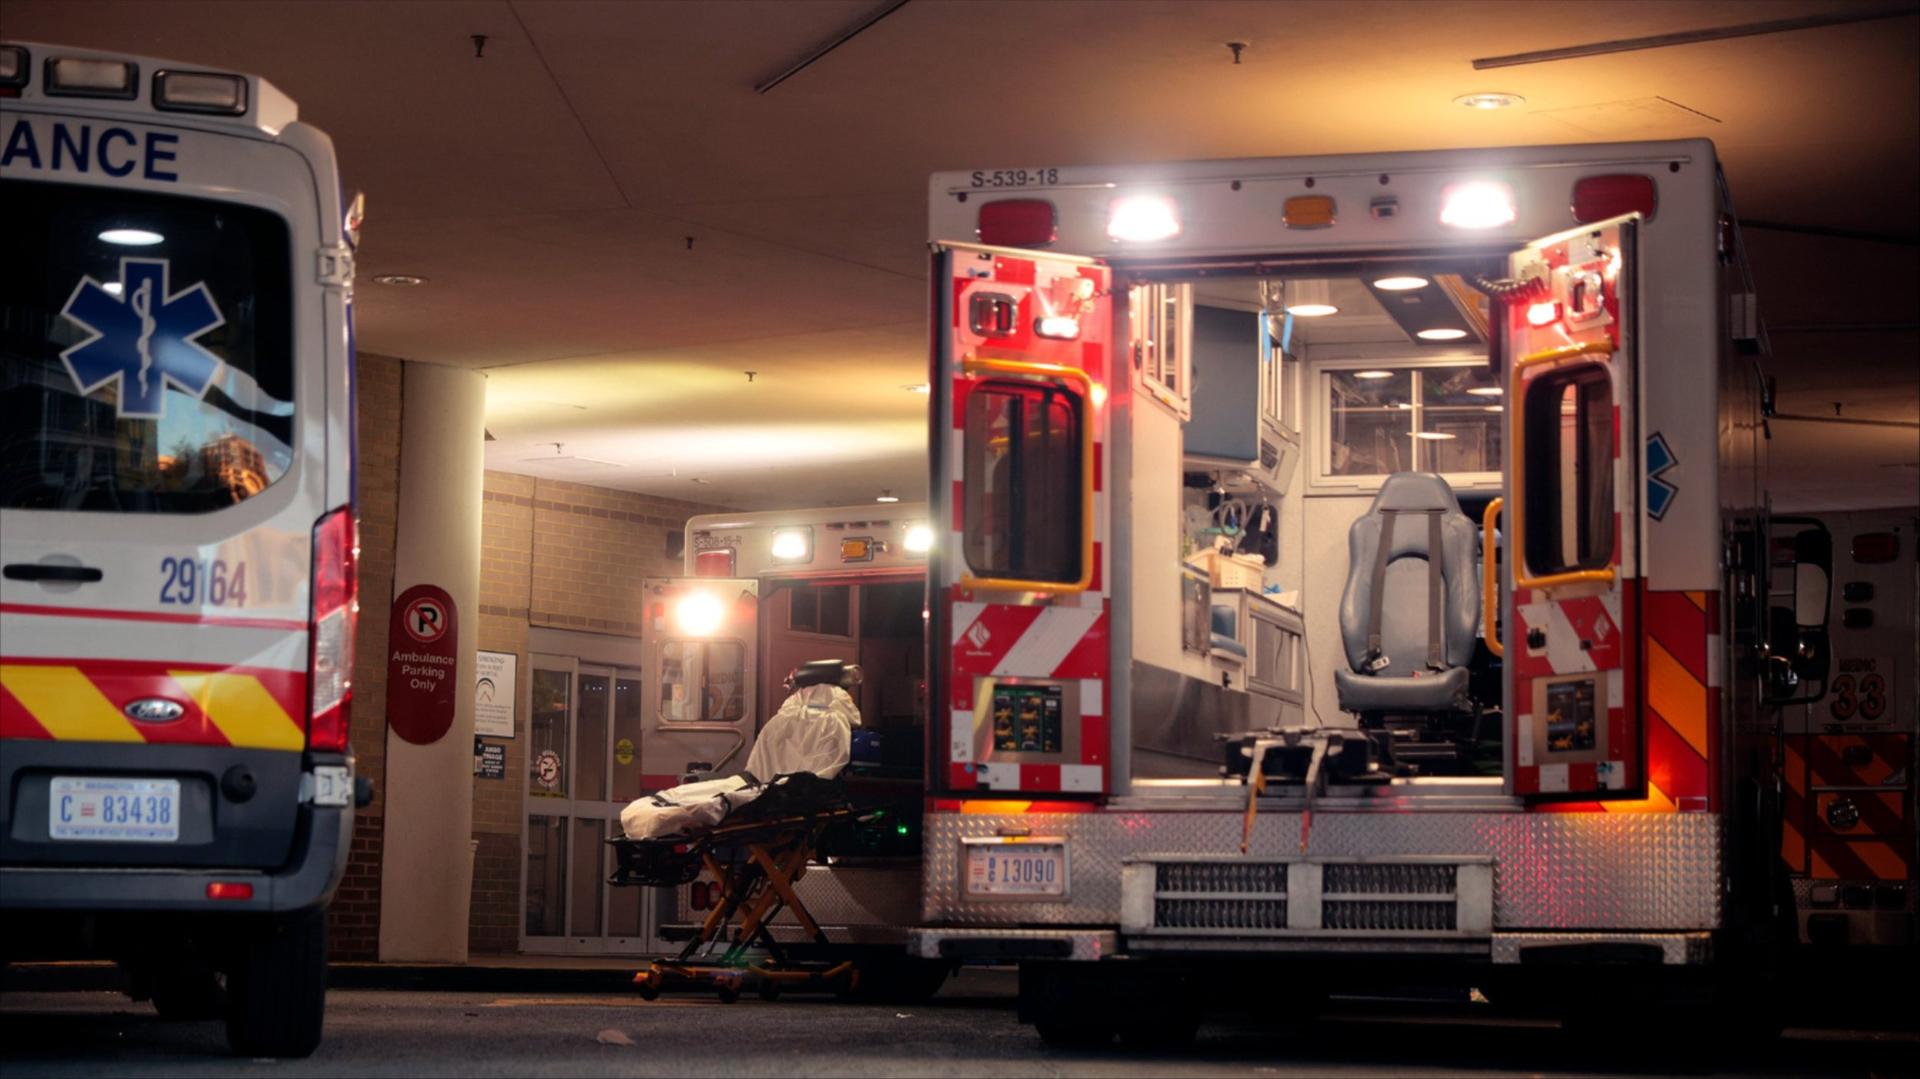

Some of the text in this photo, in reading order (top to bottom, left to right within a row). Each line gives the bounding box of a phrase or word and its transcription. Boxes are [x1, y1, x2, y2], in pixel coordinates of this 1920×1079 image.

[971, 168, 1058, 188] S-539-18
[160, 557, 247, 607] 29164
[392, 650, 455, 665] Ambulance
[402, 665, 445, 679] Parking
[410, 678, 436, 692] Only
[1830, 673, 1886, 721] 33
[60, 795, 171, 825] C 83438
[1002, 858, 1056, 882] 13090
